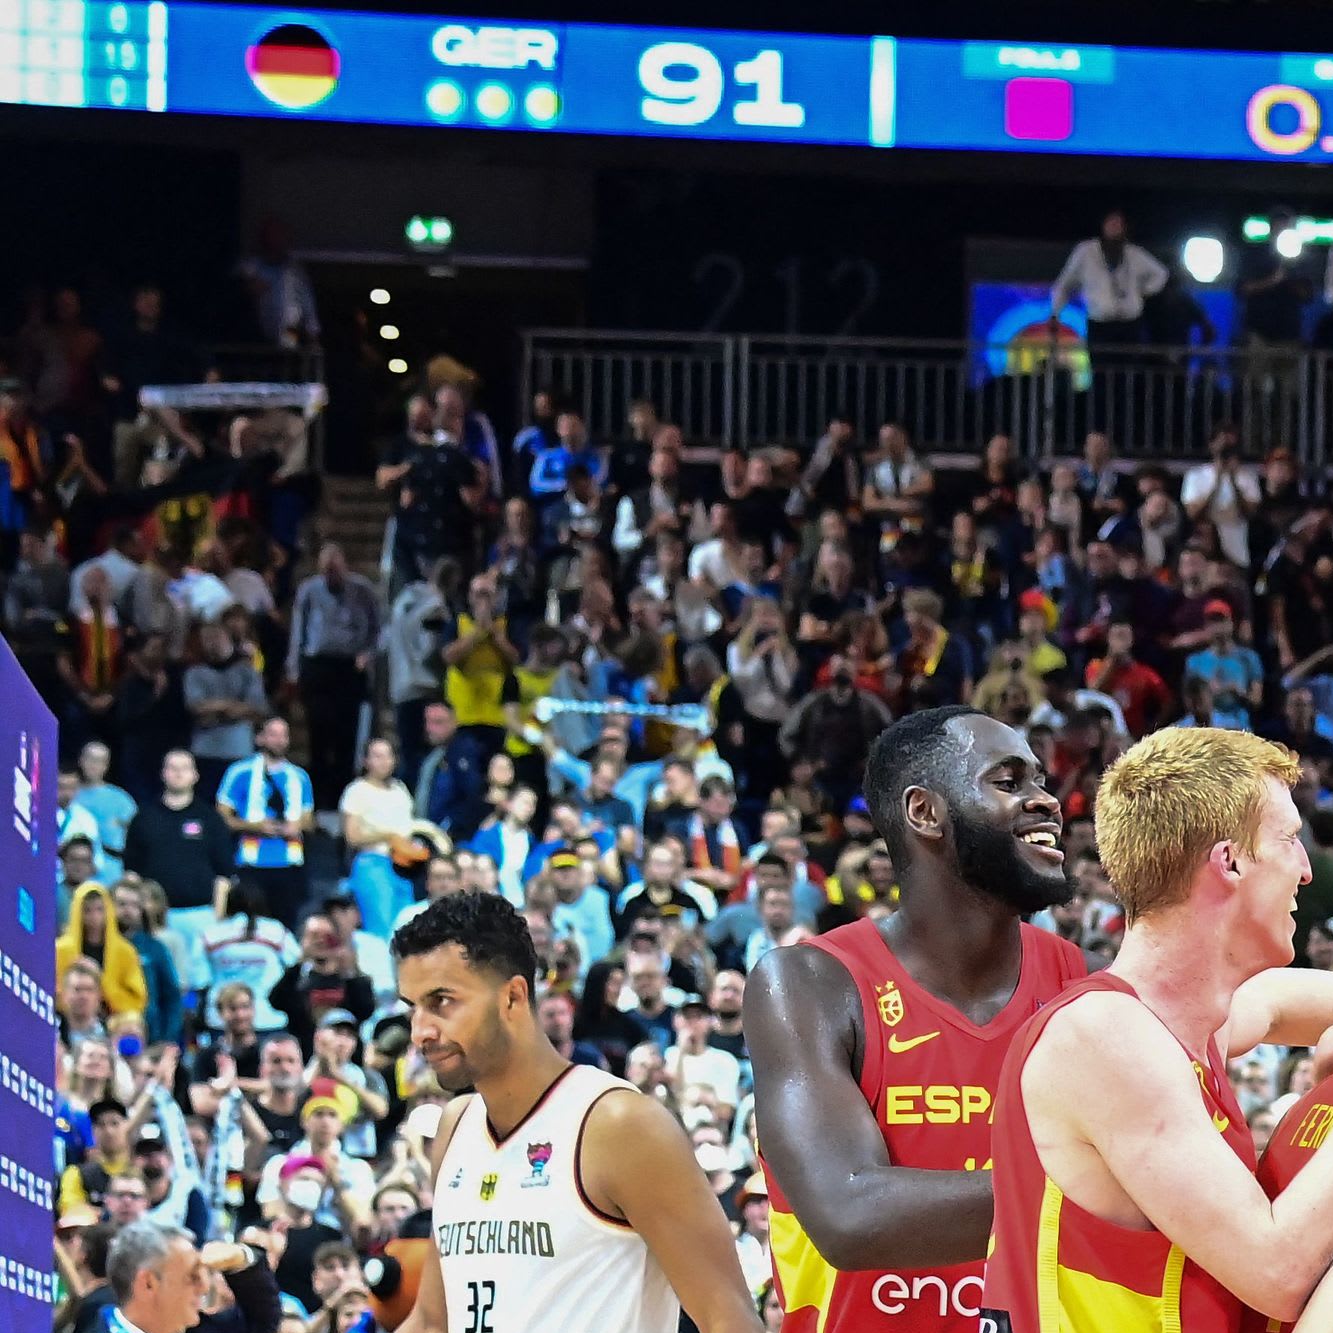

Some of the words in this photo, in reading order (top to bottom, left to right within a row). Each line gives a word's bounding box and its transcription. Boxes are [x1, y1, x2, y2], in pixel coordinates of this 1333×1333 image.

[432, 25, 558, 70] GER
[638, 42, 806, 127] 91
[886, 1085, 994, 1125] ESP
